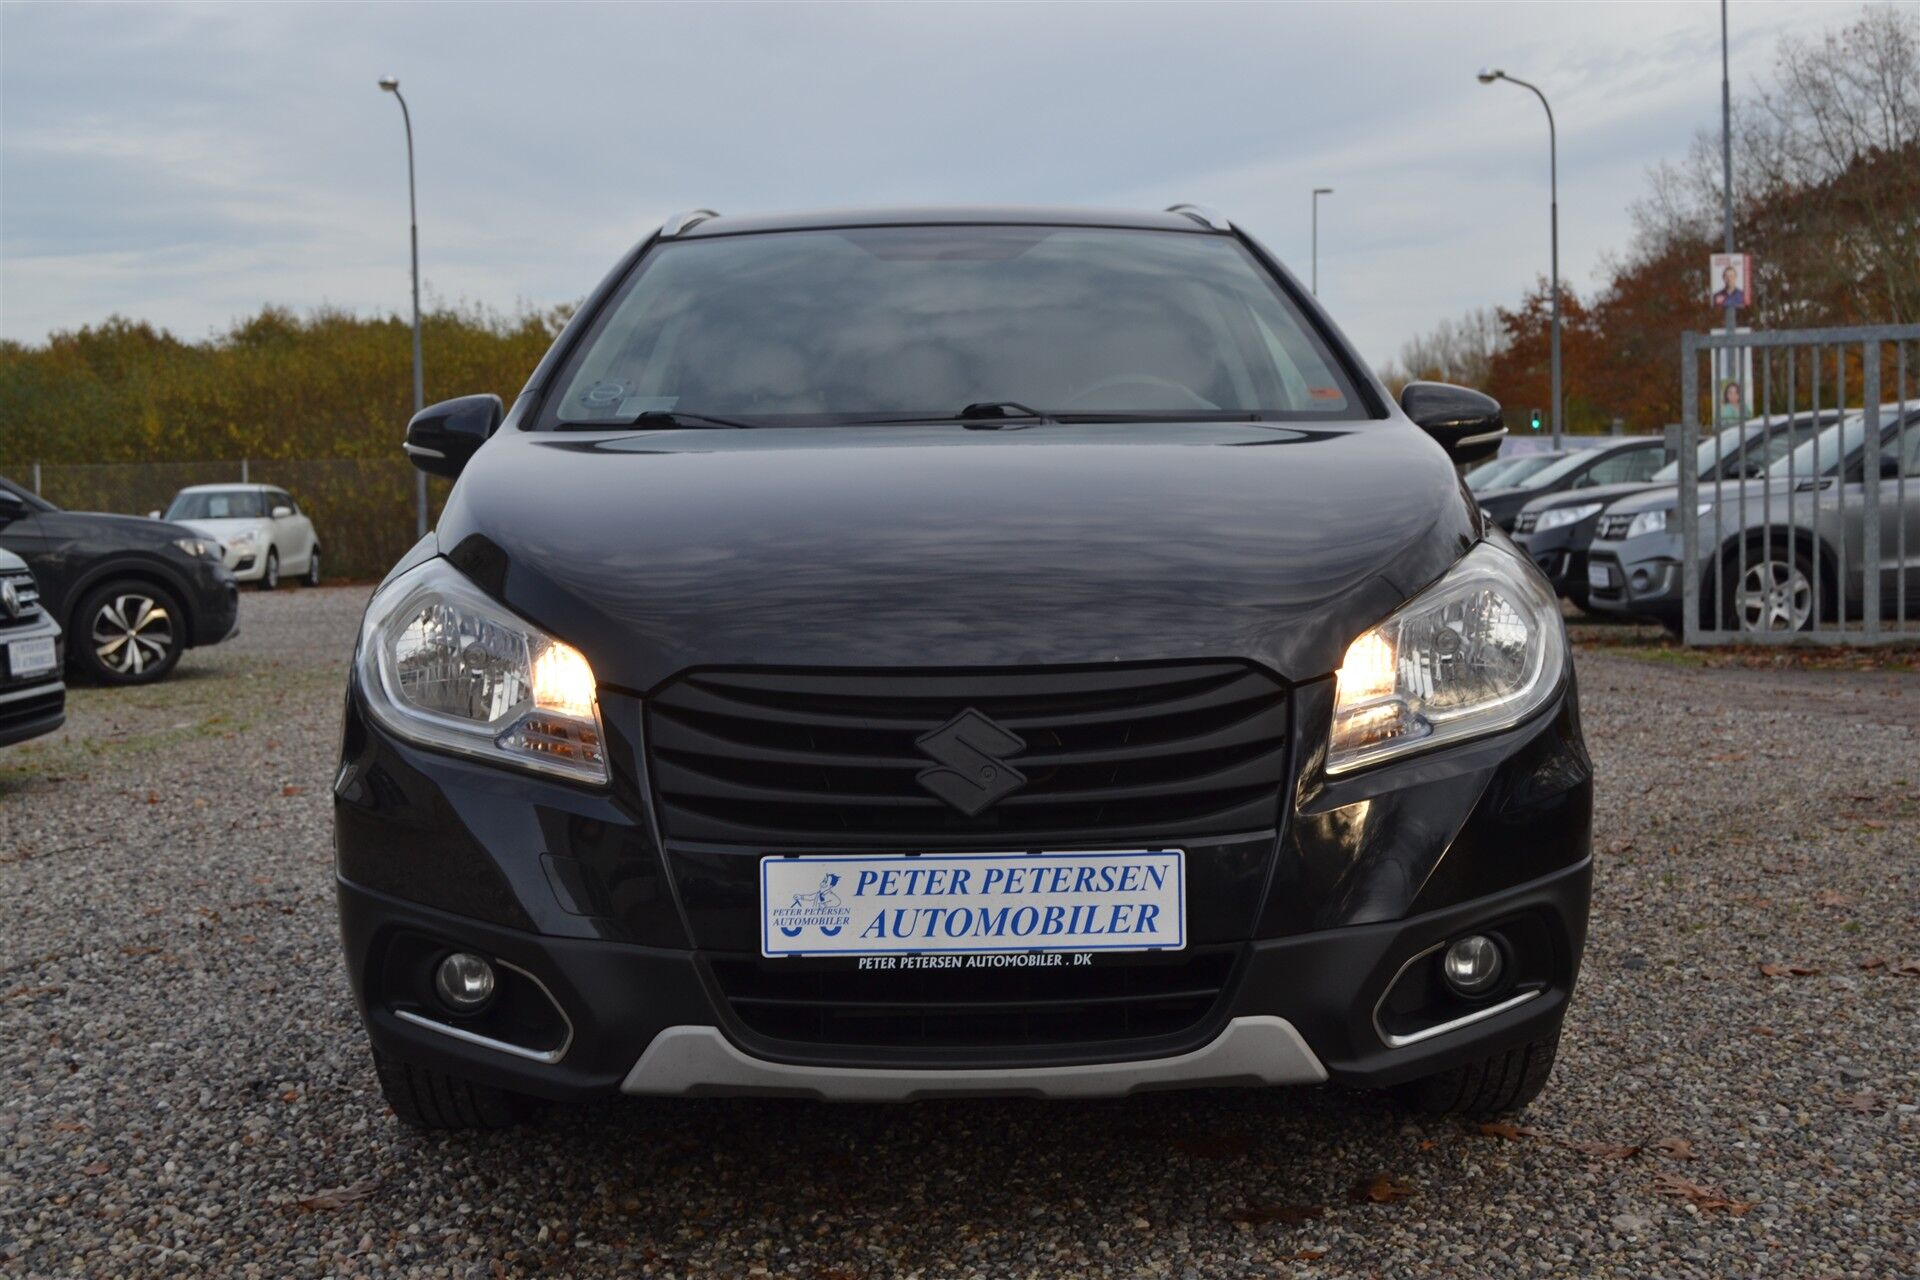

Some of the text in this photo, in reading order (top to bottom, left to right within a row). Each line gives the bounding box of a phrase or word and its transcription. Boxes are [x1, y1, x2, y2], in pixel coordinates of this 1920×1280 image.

[853, 864, 1171, 897] PETER PETERSEN
[773, 907, 851, 916] PETER PETERSEN
[772, 916, 850, 926] AUTOMOBILER
[859, 903, 1160, 939] AUTOMOBILER
[858, 956, 896, 970] PETER
[900, 955, 962, 969] PETERSEN
[965, 953, 1063, 969] AUTOMOBILER
[1073, 953, 1093, 966] DK
